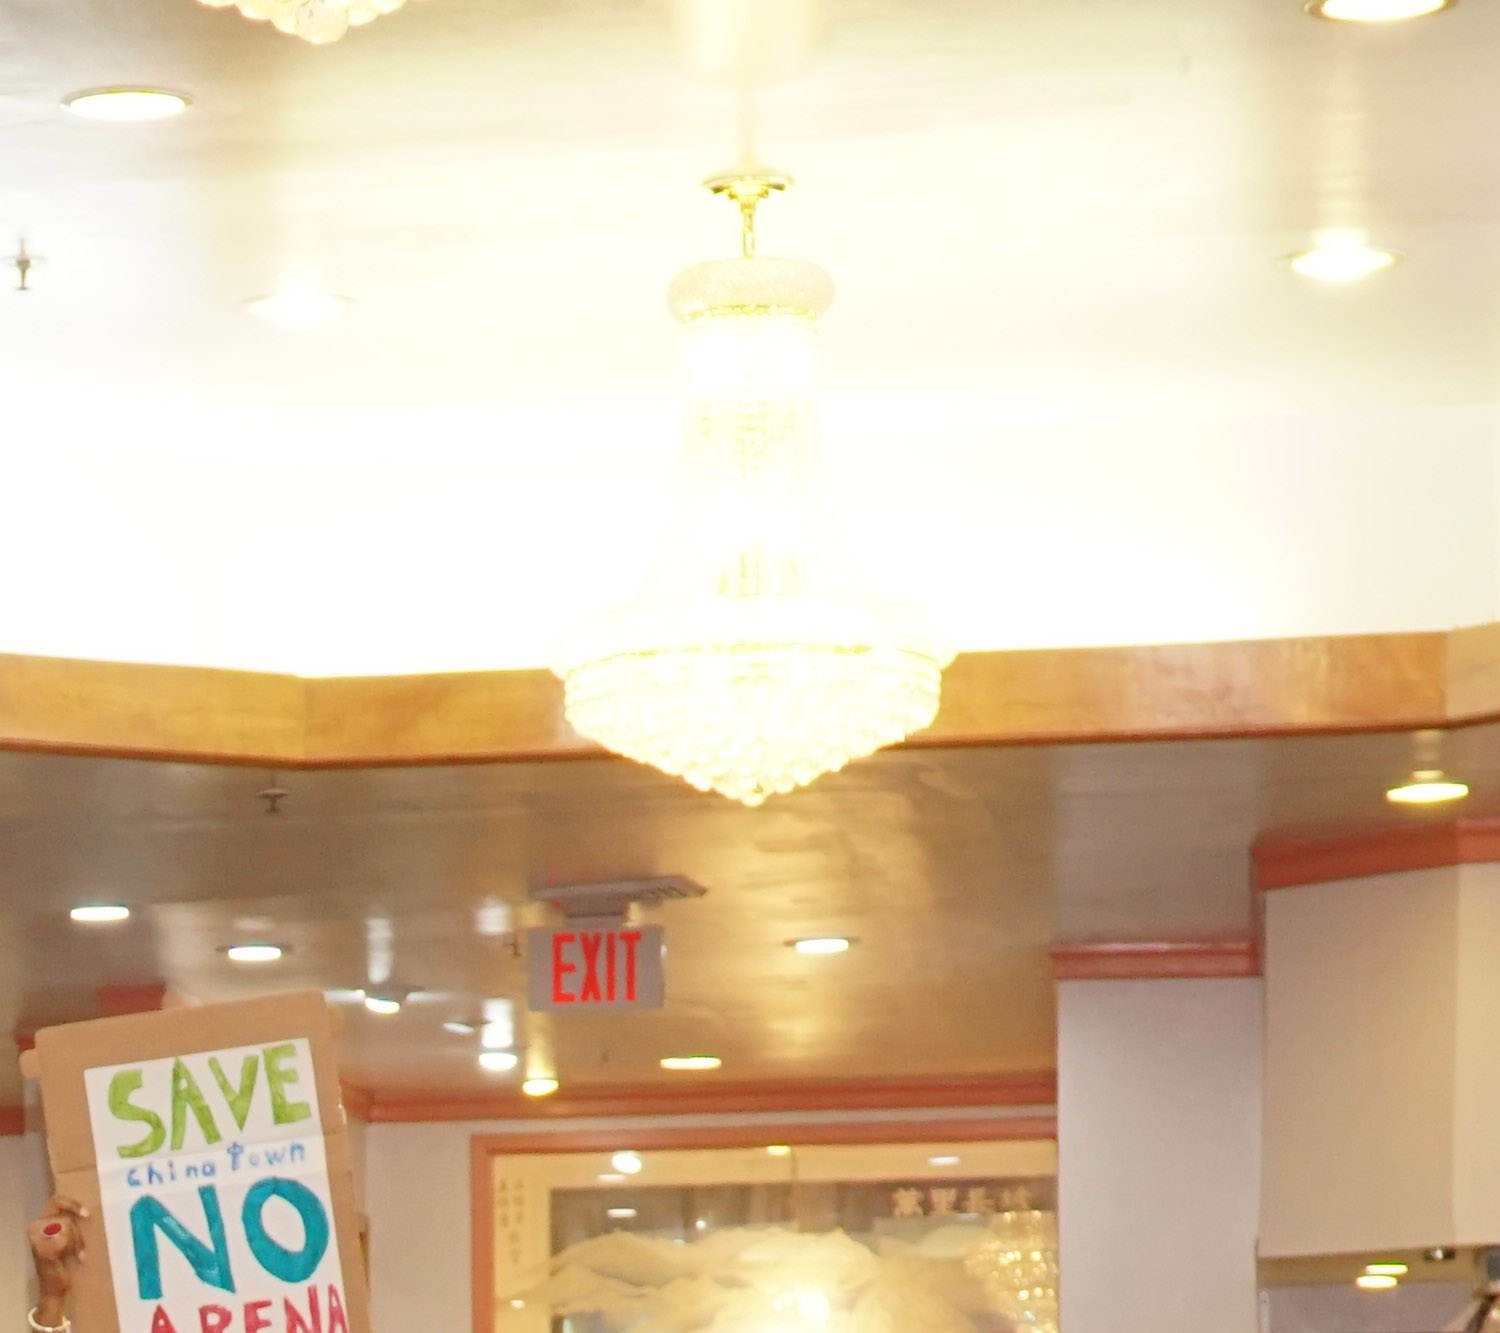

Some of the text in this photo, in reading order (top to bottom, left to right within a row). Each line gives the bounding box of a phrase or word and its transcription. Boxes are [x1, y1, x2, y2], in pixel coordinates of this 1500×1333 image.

[552, 931, 643, 1002] EXIT
[108, 1044, 311, 1158] SAVE
[130, 1176, 329, 1300] NO
